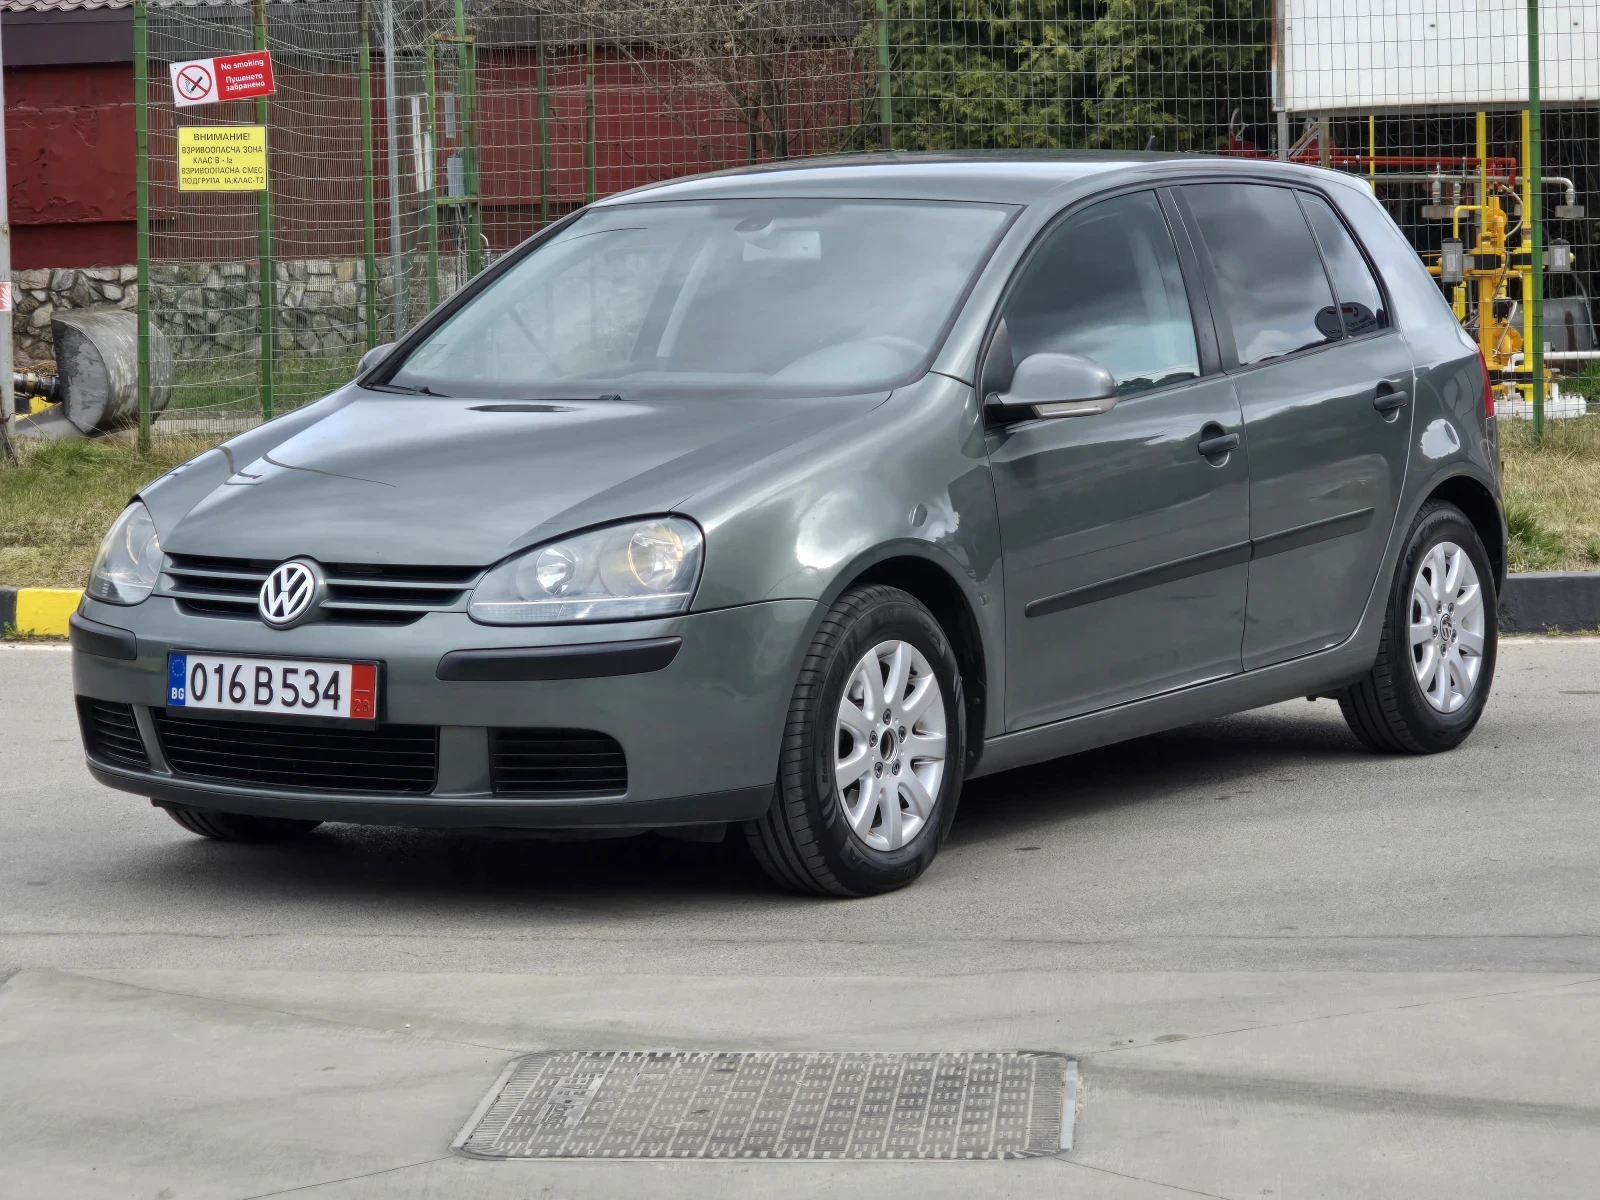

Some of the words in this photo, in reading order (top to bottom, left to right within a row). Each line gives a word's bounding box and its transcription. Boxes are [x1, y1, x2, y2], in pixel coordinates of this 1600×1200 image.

[233, 59, 264, 69] smoking
[225, 73, 263, 84] Пушенето
[225, 81, 266, 92] забранено
[193, 133, 250, 141] ВНИМАНИЕ!
[193, 156, 213, 164] КЛАС
[181, 167, 240, 175] ВЗРИВООПАСНА
[182, 177, 220, 185] ПОДГРУПА
[260, 563, 314, 623] VW
[190, 662, 341, 710] 016B534
[171, 687, 185, 700] BG
